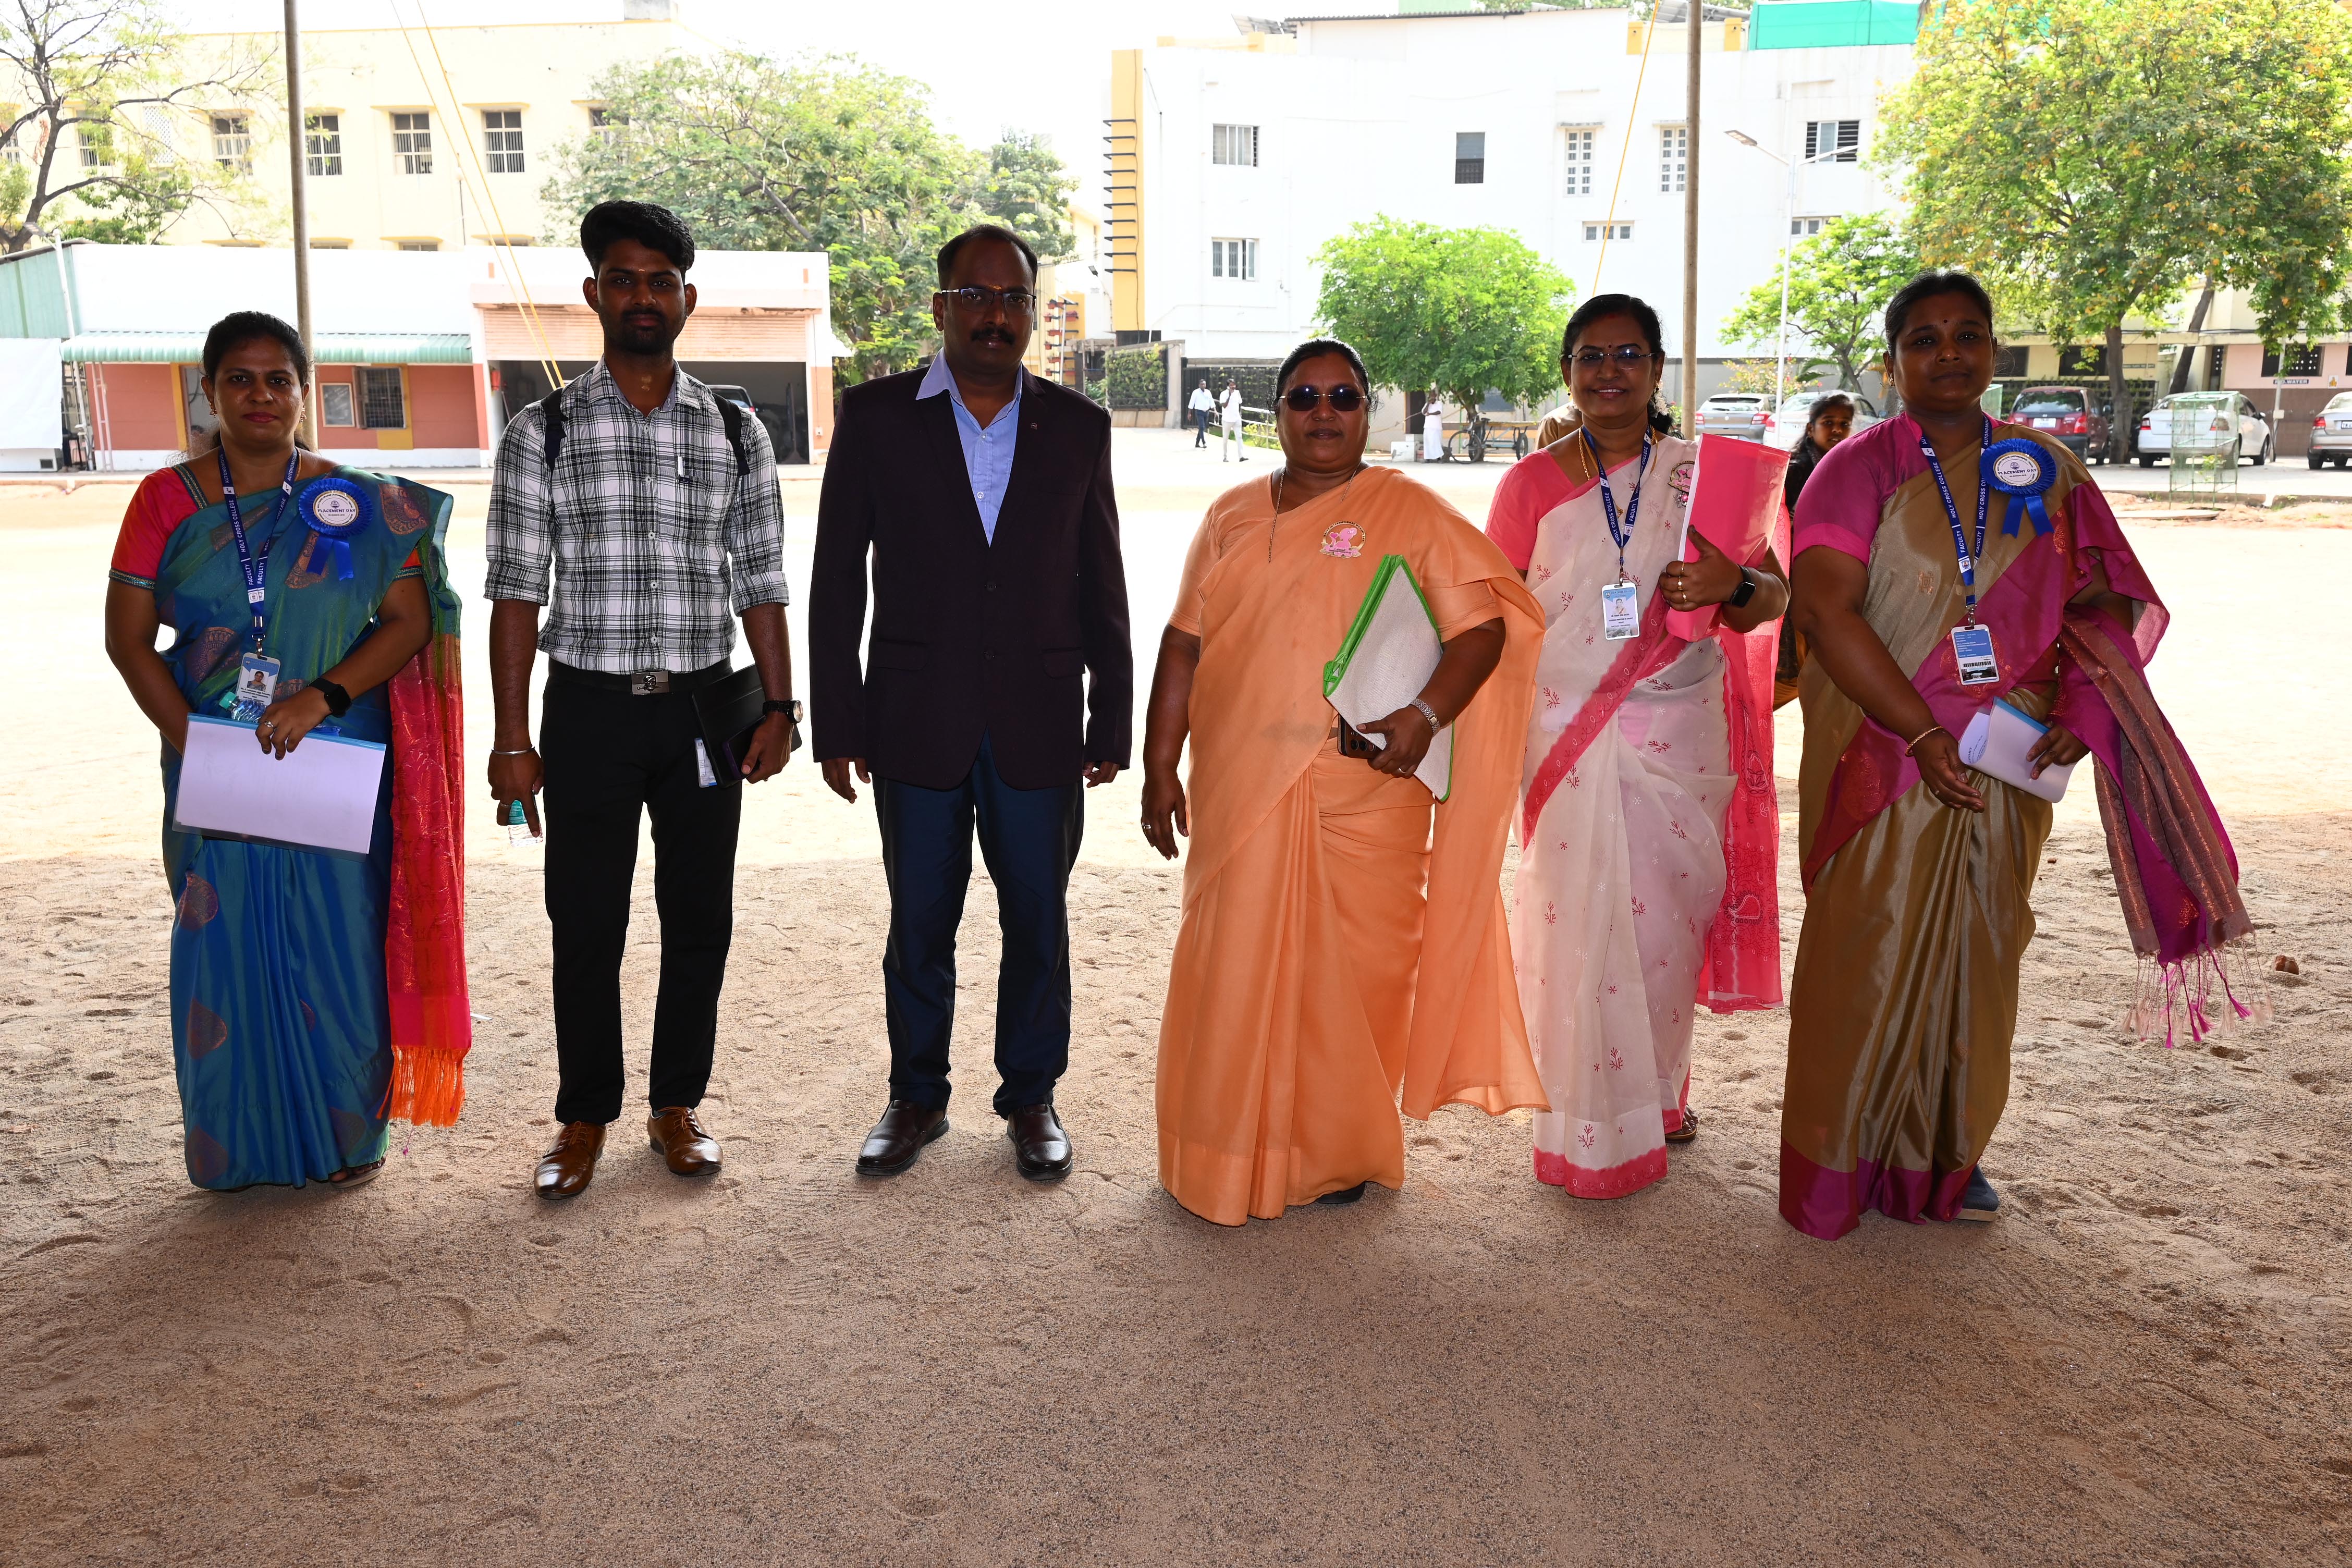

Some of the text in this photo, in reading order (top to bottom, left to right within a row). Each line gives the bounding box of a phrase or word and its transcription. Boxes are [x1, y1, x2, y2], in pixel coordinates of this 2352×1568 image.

[287, 453, 297, 481] AUTONOMOUS
[1933, 462, 1957, 518] HOLY CROSS COLLEGE
[228, 499, 238, 520] COLLEGE
[234, 521, 242, 538] CROSS
[1956, 531, 1965, 553] FACULTY
[244, 564, 254, 585] FACULTY
